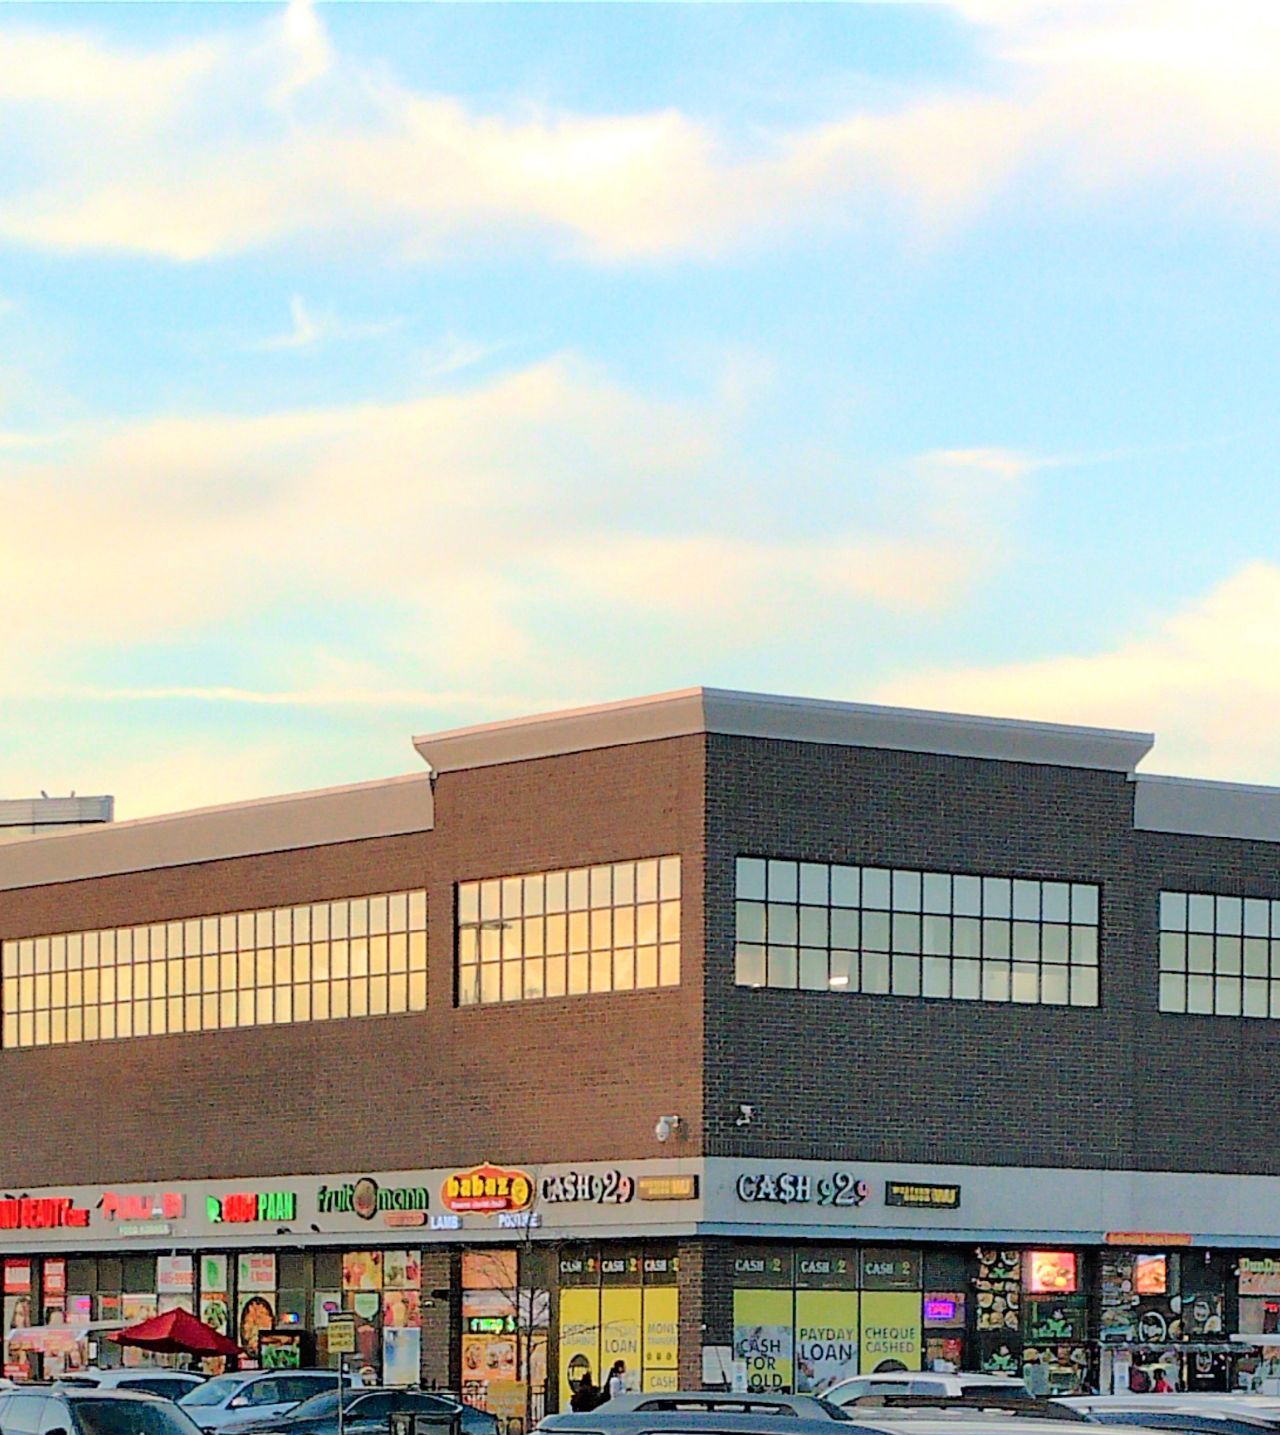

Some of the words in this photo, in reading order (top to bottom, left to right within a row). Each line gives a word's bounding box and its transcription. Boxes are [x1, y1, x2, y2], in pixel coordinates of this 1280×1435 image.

[591, 1170, 632, 1203] 929
[818, 1172, 871, 1206] 929
[258, 1192, 295, 1221] PAAN
[799, 1327, 853, 1341] PAYDAY
[865, 1327, 915, 1340] CHEQUE
[604, 1339, 637, 1353] LOAN
[738, 1338, 780, 1353] CASH
[801, 1344, 852, 1361] LOAN
[866, 1341, 914, 1353] CASHED
[746, 1357, 776, 1370] FOR
[650, 1376, 676, 1388] CASH
[747, 1374, 783, 1388] OLD
